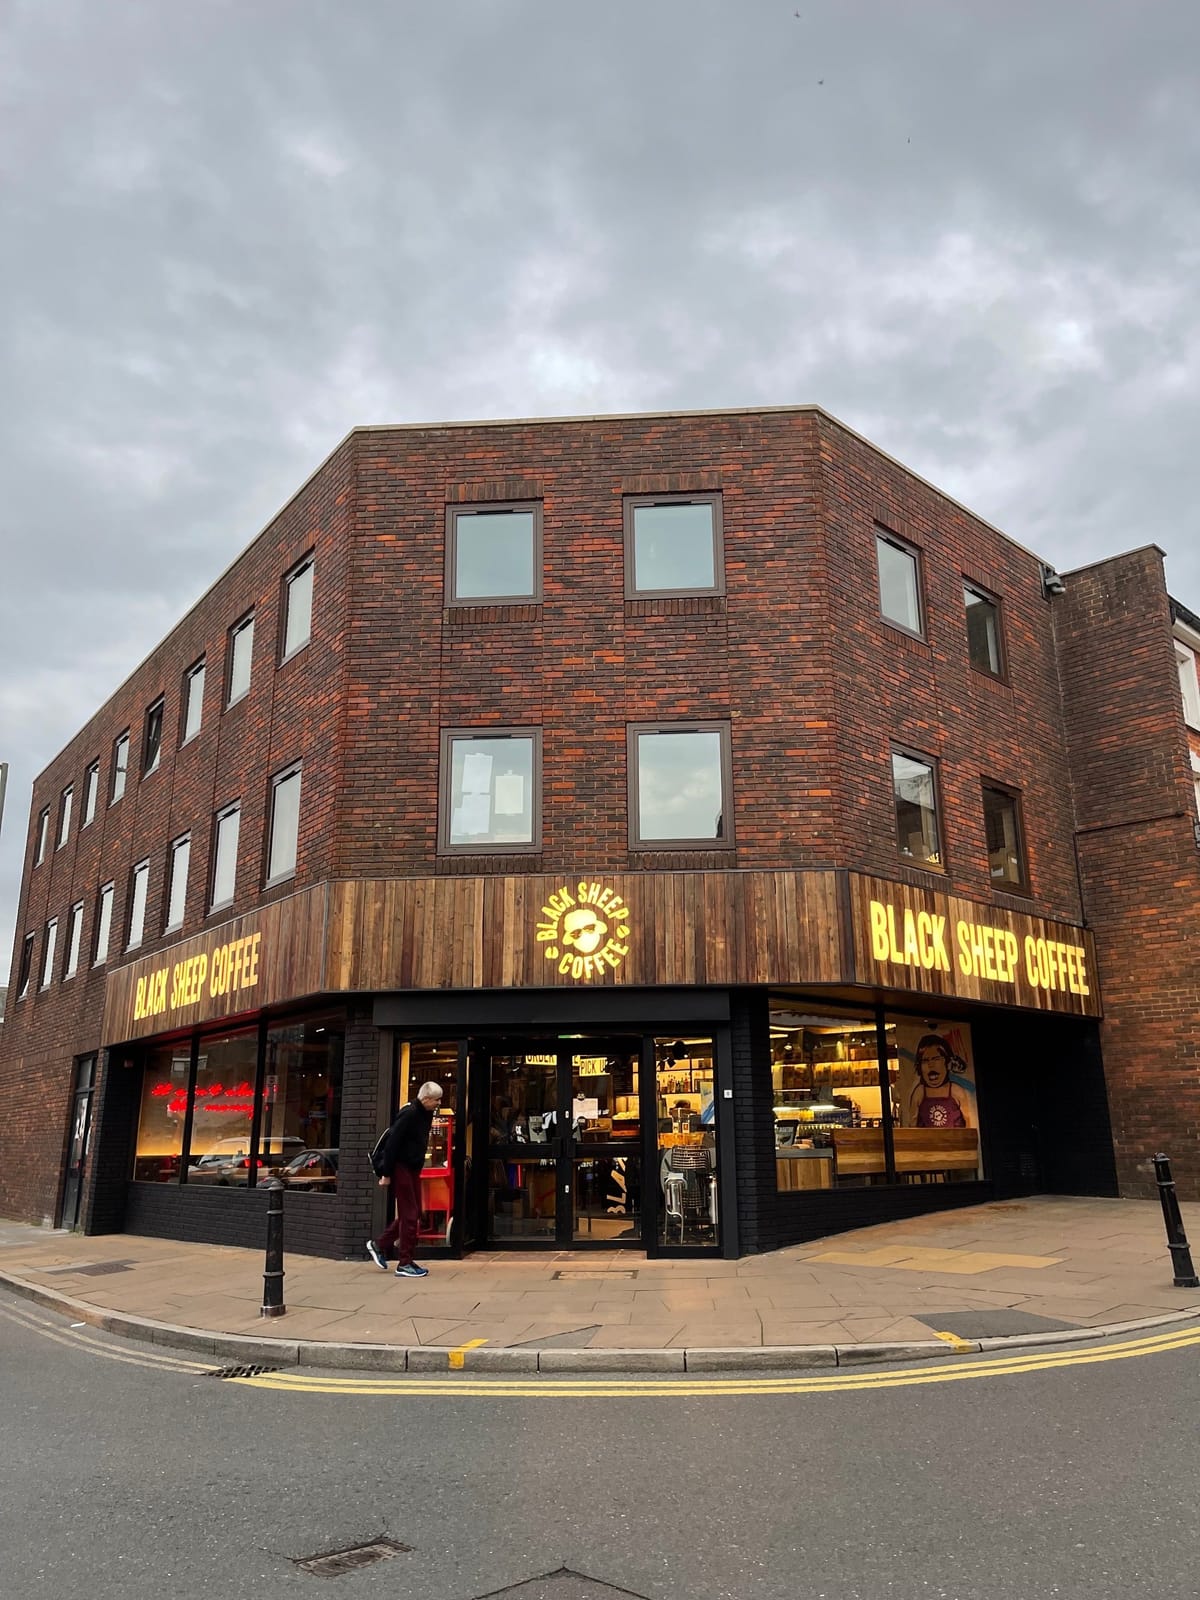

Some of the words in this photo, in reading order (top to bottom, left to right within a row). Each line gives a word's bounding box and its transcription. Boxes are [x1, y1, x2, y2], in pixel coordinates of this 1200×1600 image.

[536, 886, 576, 941] BLACK
[577, 882, 630, 919] SHEEP
[134, 967, 169, 1021] BLACK
[170, 953, 208, 1010] SHEEP
[209, 932, 261, 998] COFFEE
[558, 938, 630, 979] COFFEE
[870, 900, 951, 972] BLACK
[957, 920, 1019, 983] SHEEP
[1025, 935, 1090, 996] COFFEE
[580, 1059, 597, 1075] PICK
